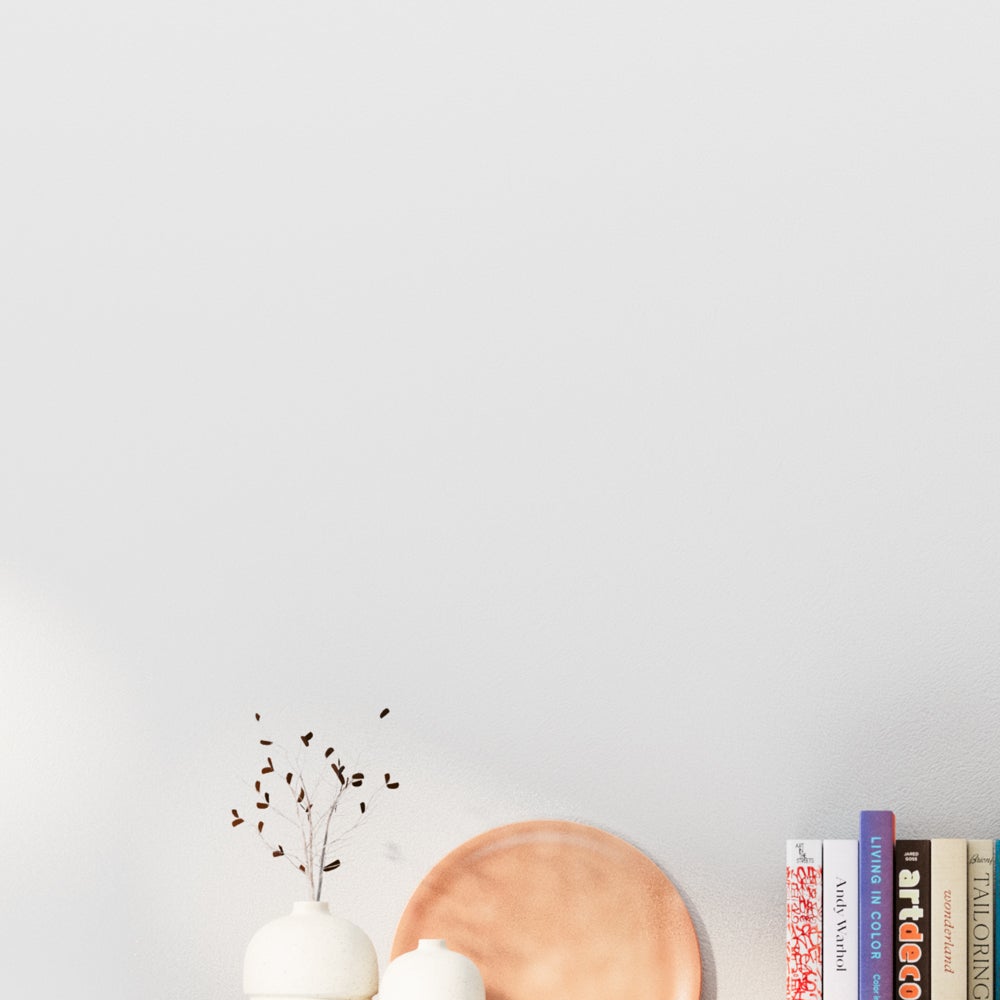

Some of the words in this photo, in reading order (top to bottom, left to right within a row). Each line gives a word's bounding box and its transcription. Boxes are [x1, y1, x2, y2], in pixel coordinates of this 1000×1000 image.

[871, 836, 882, 884] LIVING
[833, 876, 847, 914] Andy
[871, 891, 882, 905] IN
[836, 915, 847, 971] Warhol
[871, 911, 882, 960] COLOR
[943, 889, 955, 974] wonderland
[973, 872, 990, 1000] TAILORING
[873, 973, 881, 994] Color
